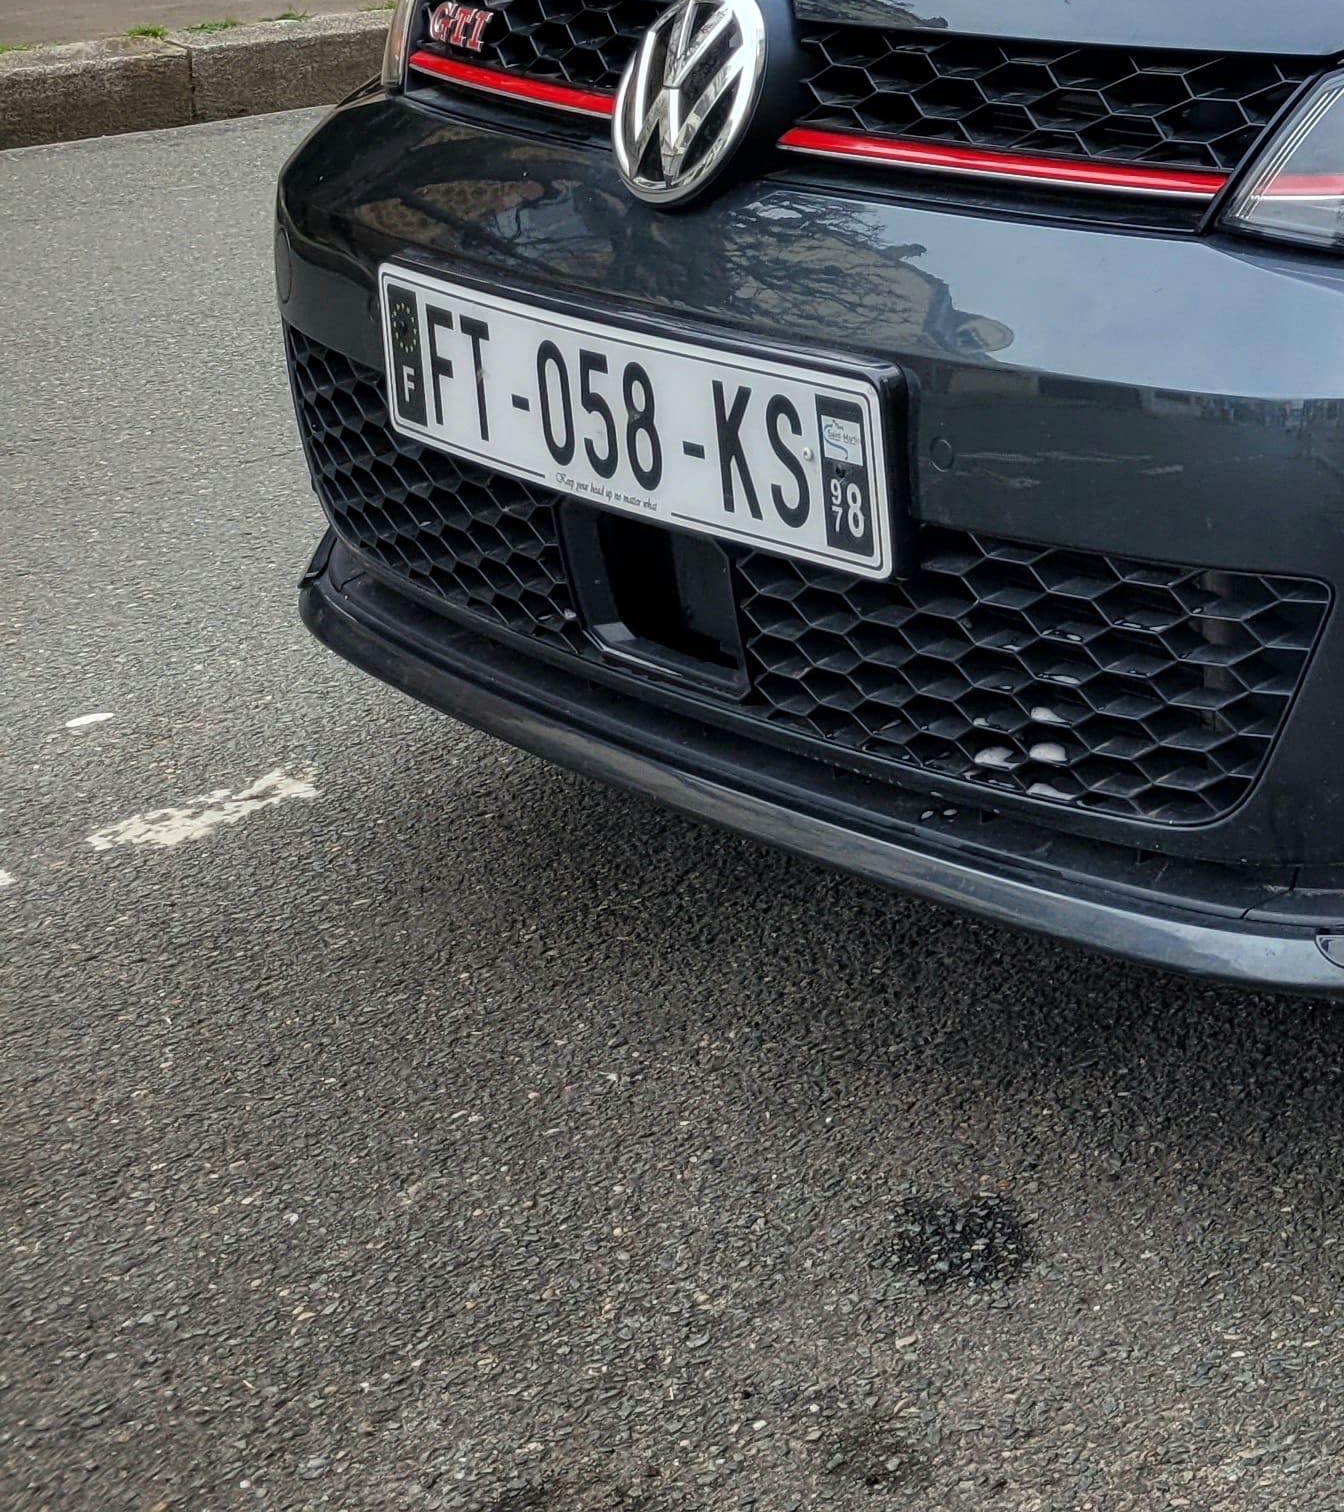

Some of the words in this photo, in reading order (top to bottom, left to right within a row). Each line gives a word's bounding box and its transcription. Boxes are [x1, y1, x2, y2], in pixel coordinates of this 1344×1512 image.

[429, 1, 494, 53] GTI
[402, 364, 415, 403] F
[425, 303, 811, 529] FT-058-KS
